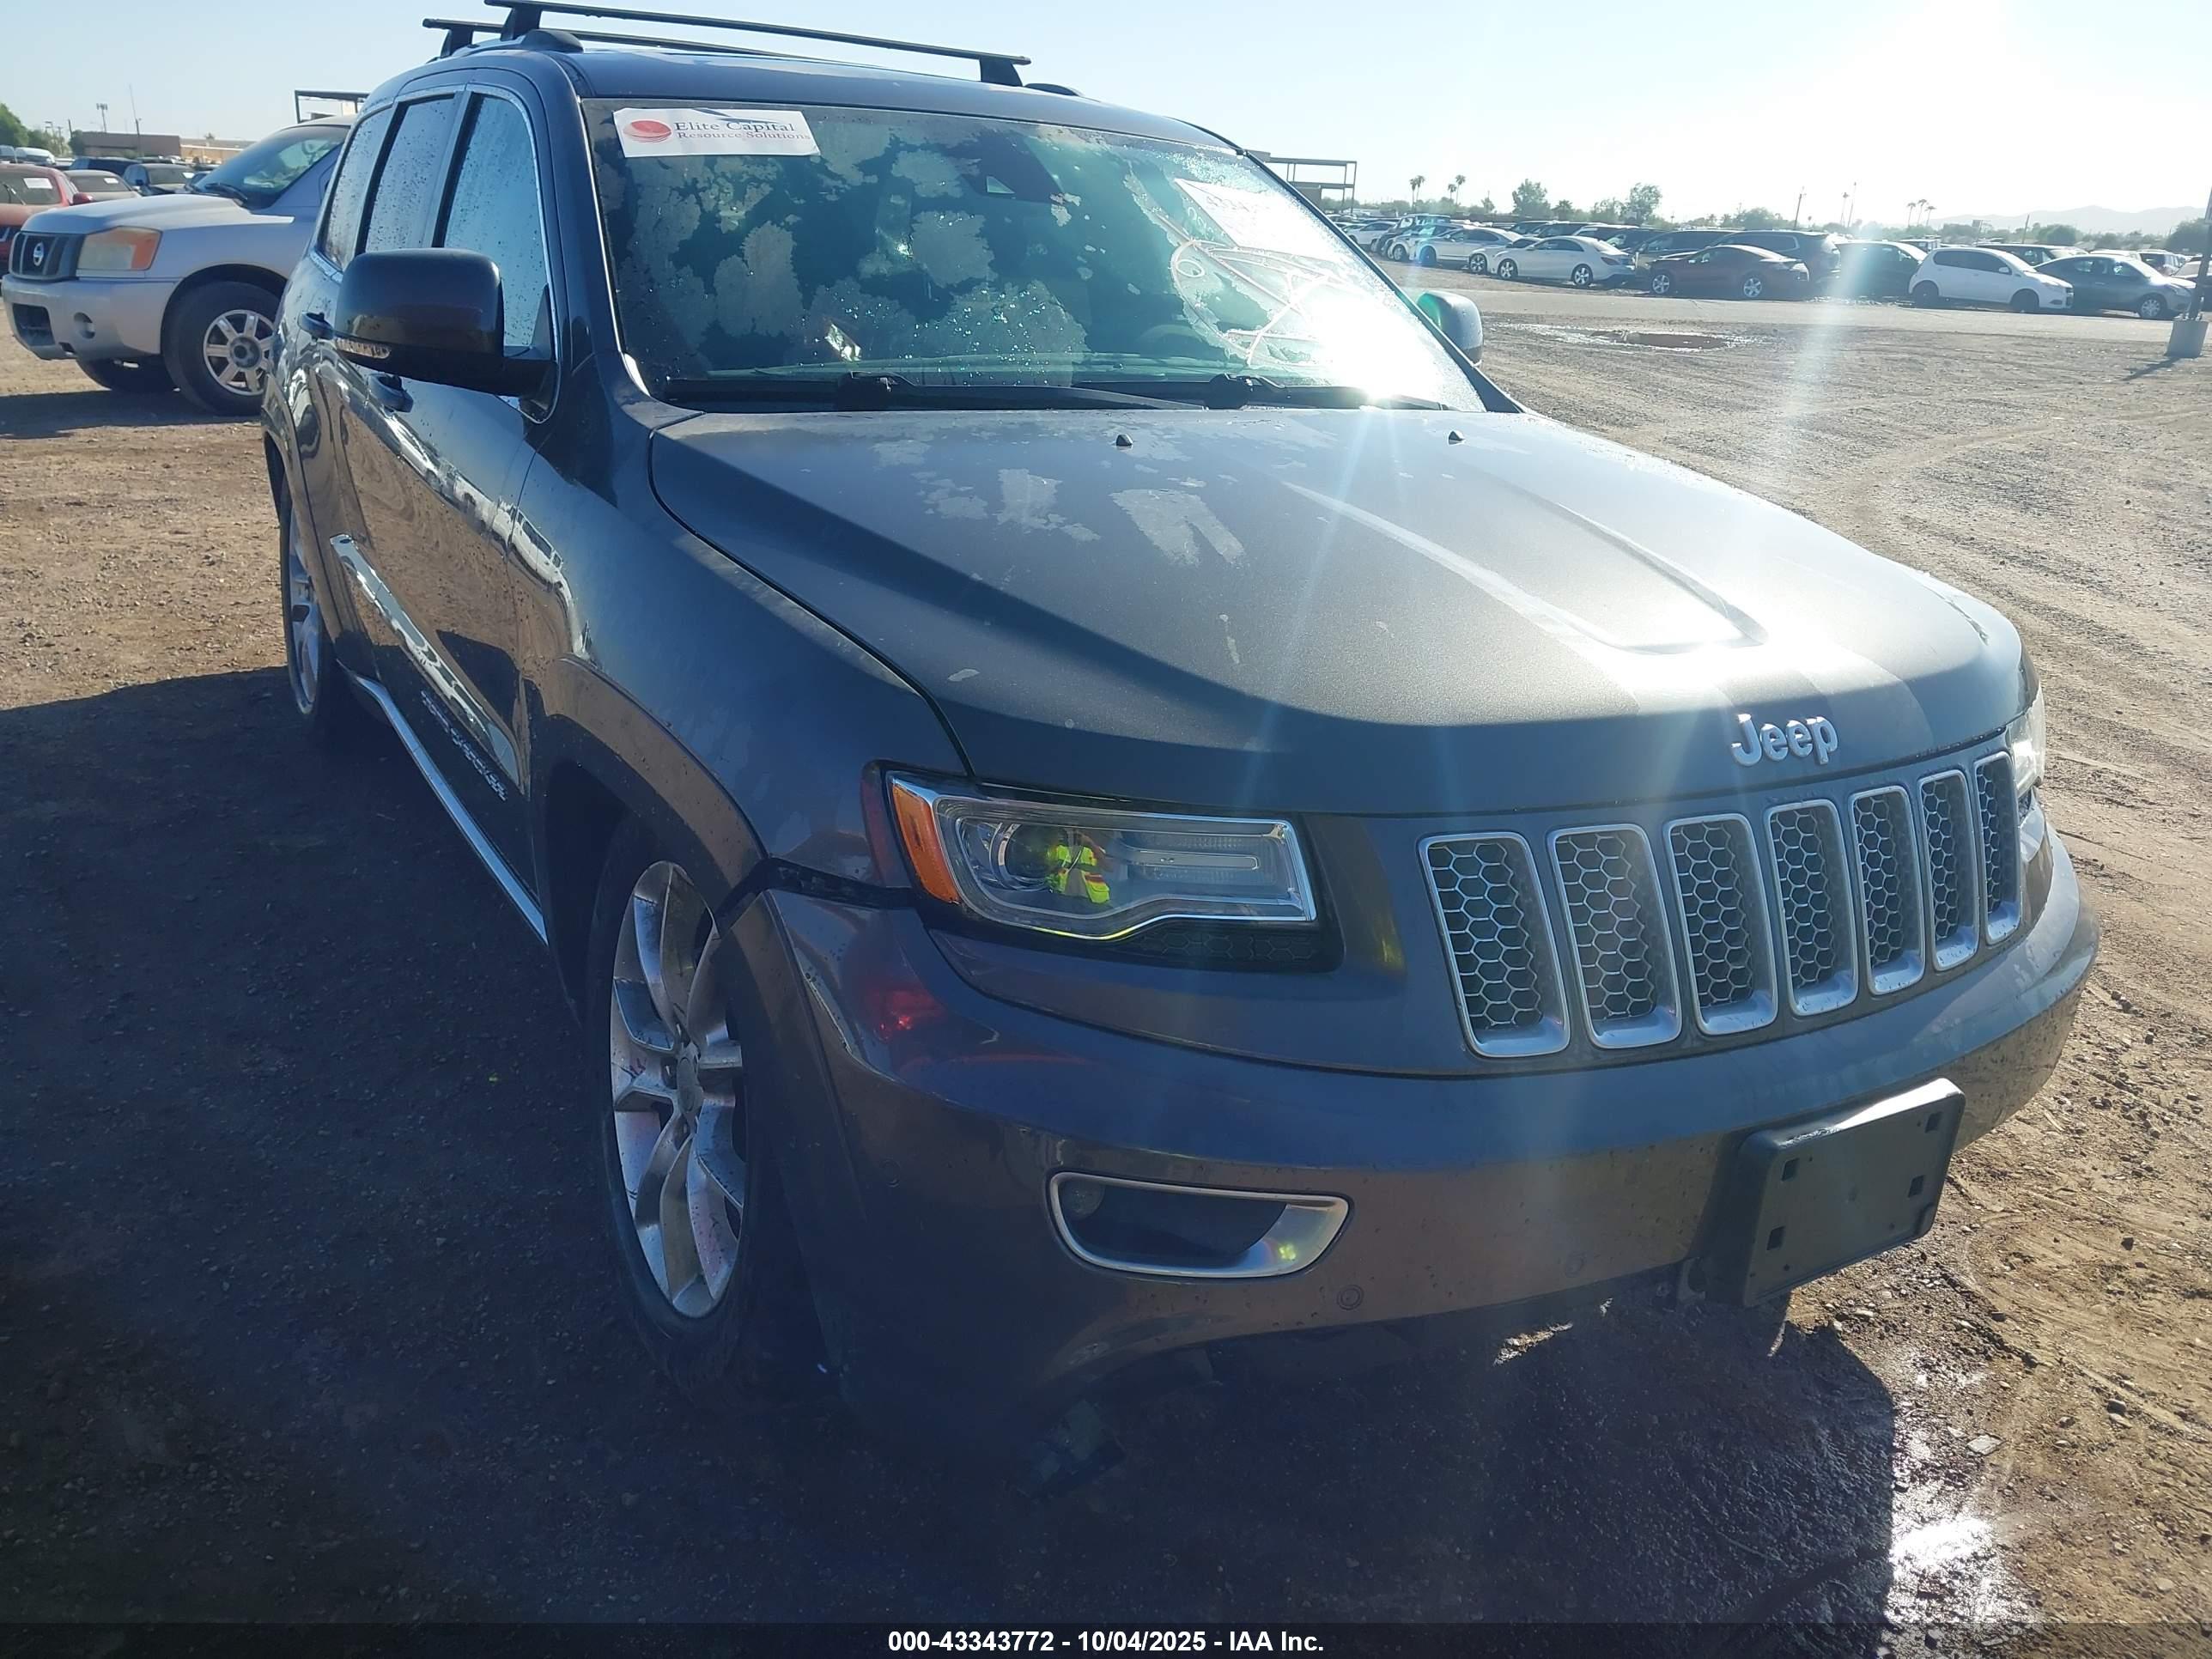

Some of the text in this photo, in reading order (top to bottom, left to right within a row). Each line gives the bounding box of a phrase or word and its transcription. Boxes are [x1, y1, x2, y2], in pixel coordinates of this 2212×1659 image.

[674, 120, 795, 133] Elite Capital
[678, 131, 811, 140] Resource Solutions
[1731, 713, 1838, 766] Jeep
